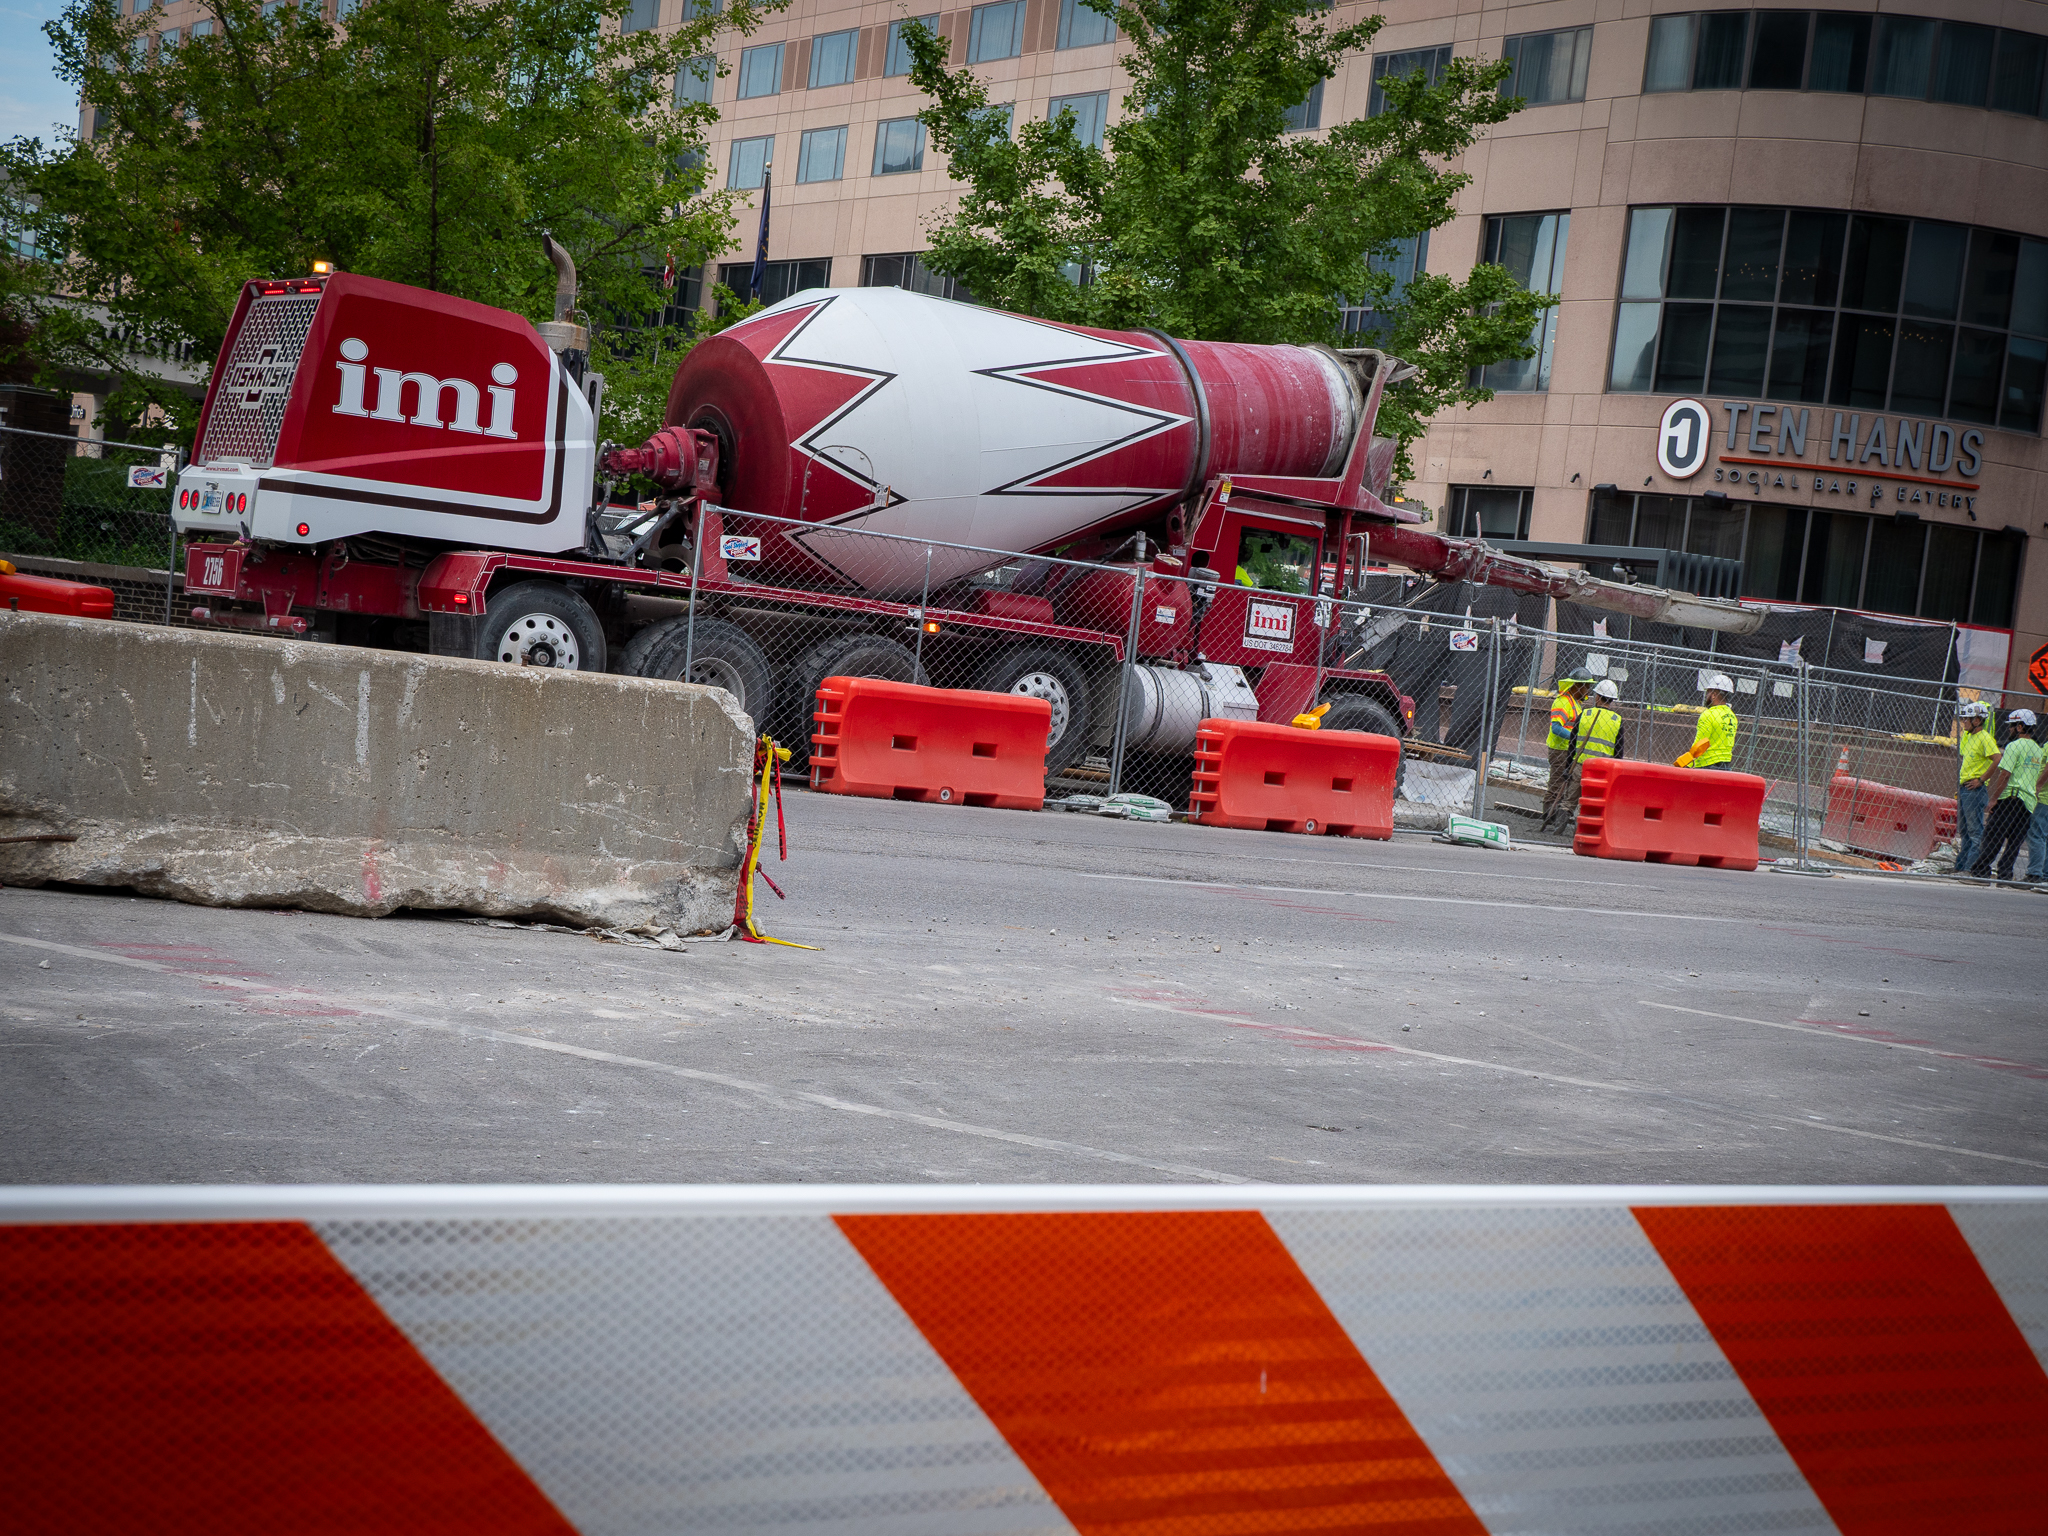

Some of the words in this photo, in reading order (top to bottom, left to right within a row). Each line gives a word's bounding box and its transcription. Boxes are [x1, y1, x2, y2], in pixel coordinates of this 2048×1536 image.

[332, 337, 518, 440] imi
[1723, 402, 1809, 455] TEN
[1829, 412, 1984, 476] HANDS
[1714, 468, 1799, 489] SOCIAL
[1814, 477, 1858, 494] BAR
[1872, 484, 1883, 498] &
[1897, 487, 1977, 510] EATERY
[203, 557, 224, 586] 2756
[1253, 610, 1288, 631] imi
